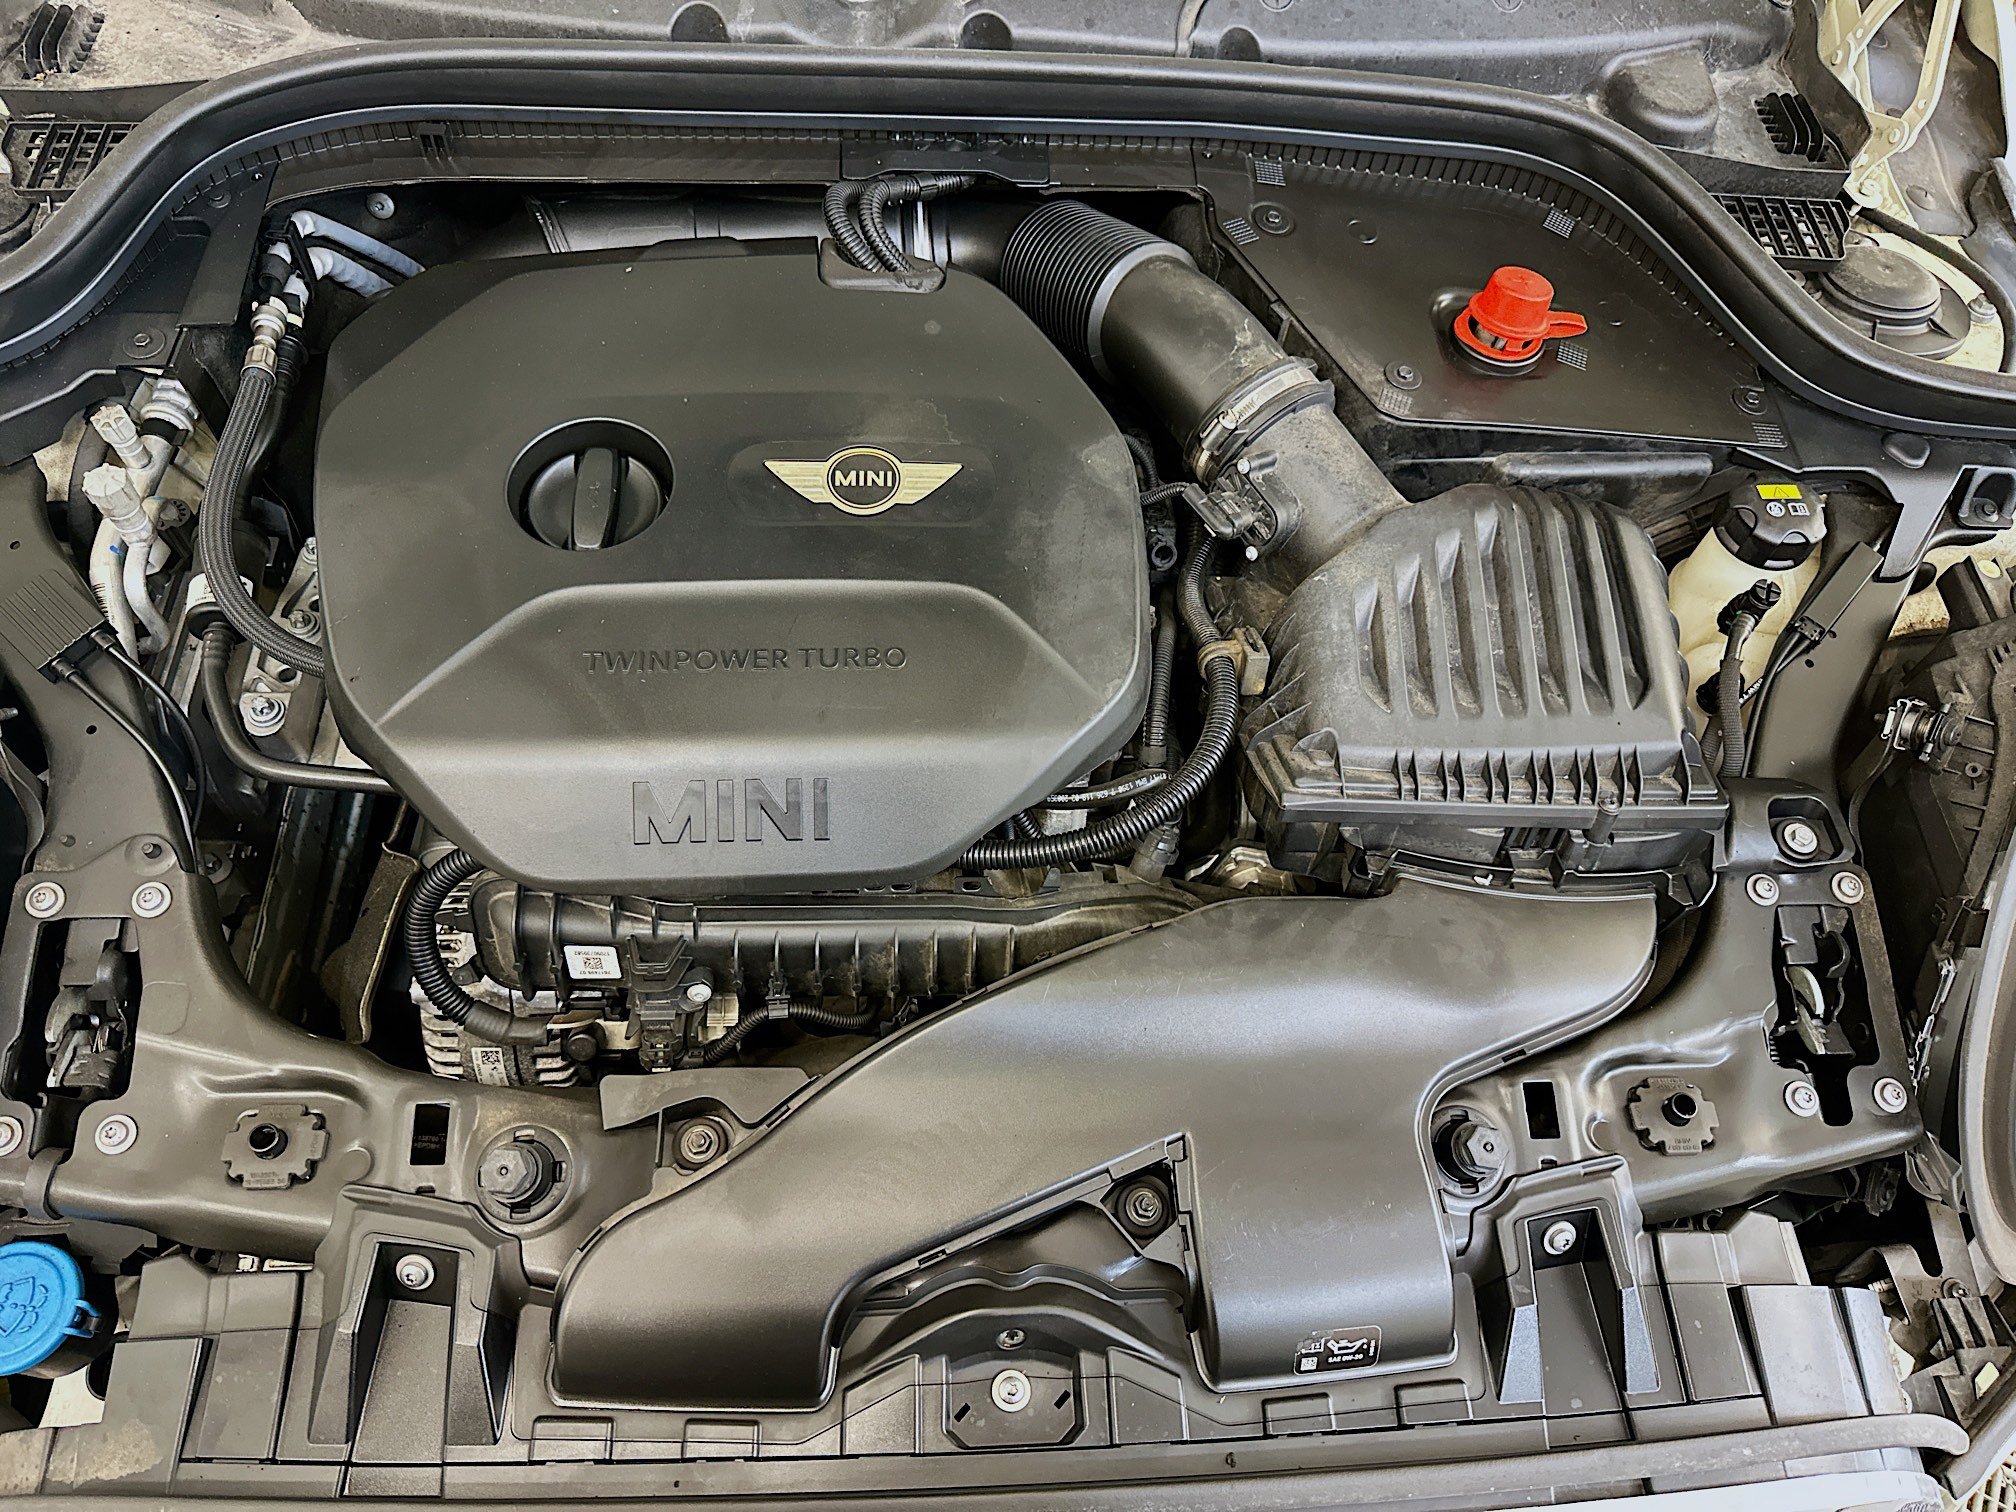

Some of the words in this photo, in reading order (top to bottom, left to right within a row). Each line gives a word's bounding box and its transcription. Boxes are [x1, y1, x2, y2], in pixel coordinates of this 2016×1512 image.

[834, 470, 893, 487] MINI
[583, 649, 789, 675] TWINPOWER
[798, 647, 908, 671] TURBO
[1135, 778, 1147, 787] BMW
[632, 777, 831, 845] MINI
